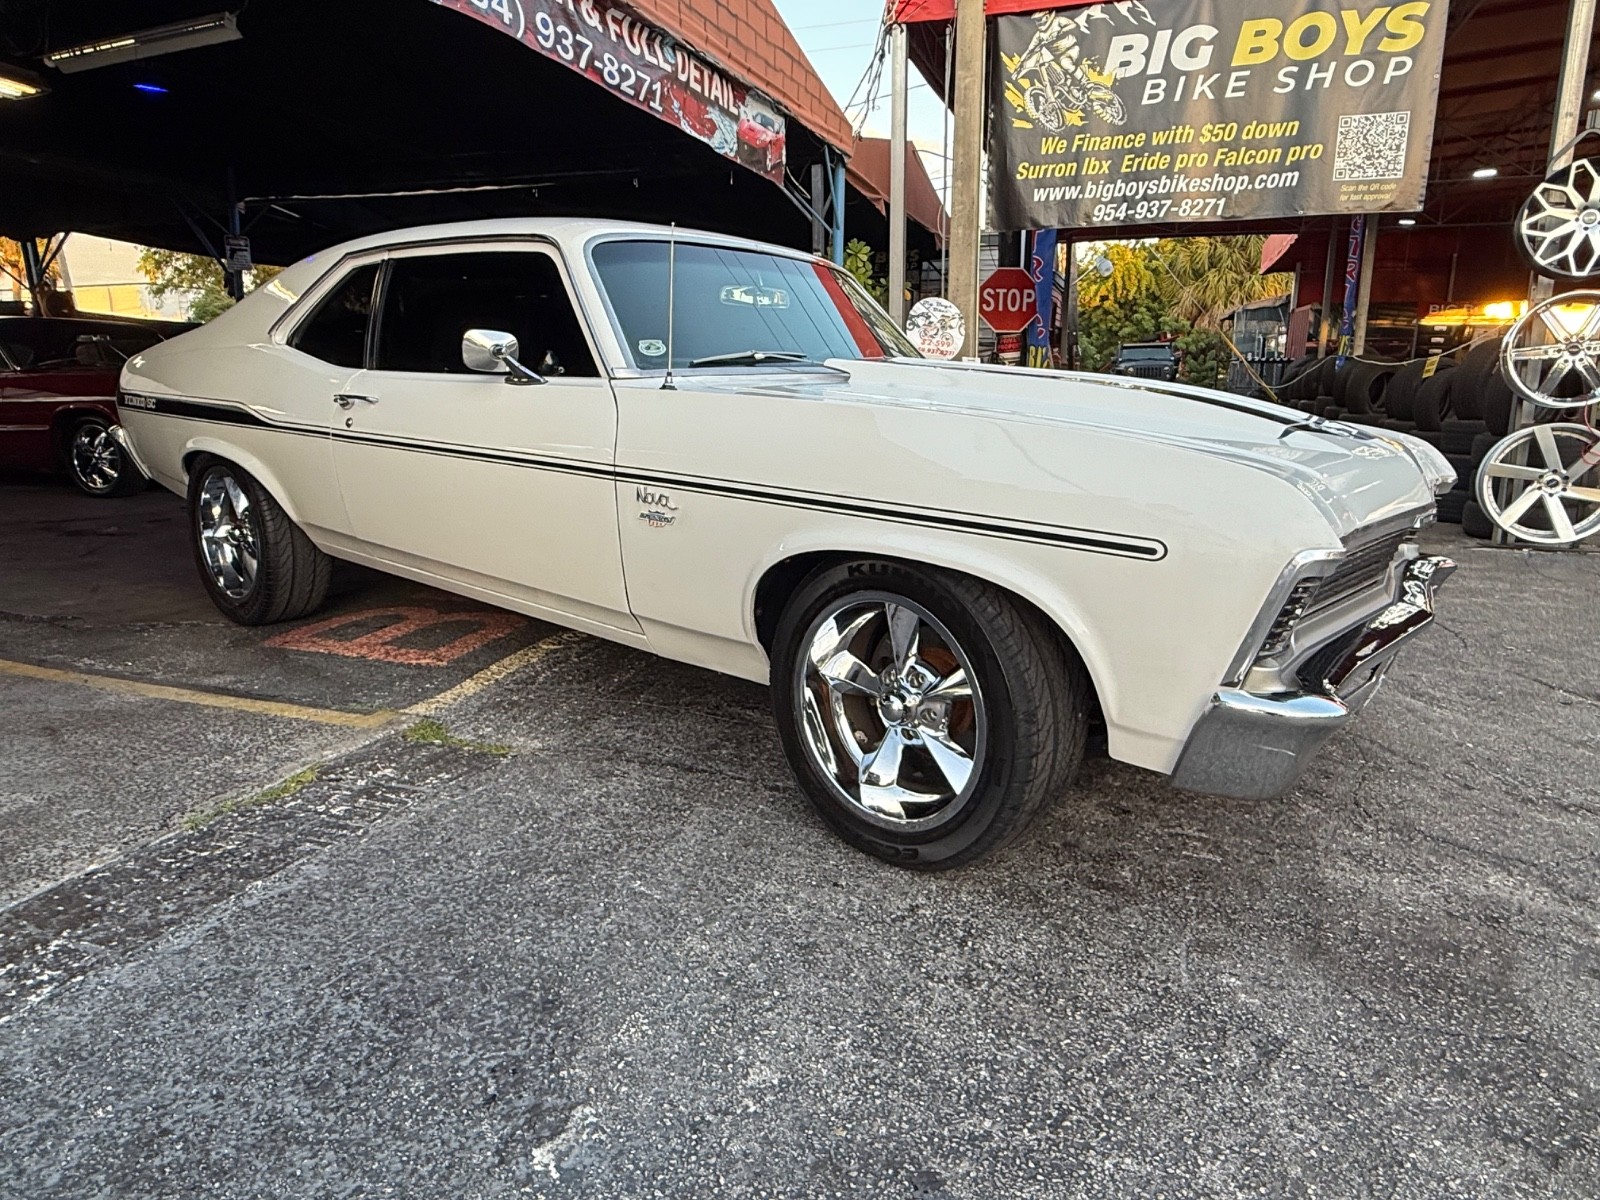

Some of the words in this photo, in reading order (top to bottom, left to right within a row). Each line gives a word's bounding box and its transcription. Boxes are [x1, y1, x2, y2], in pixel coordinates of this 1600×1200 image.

[1106, 24, 1219, 79] BIG
[1230, 2, 1431, 67] BOYS
[535, 11, 663, 113] 937-8271
[605, 7, 672, 73] FULL
[675, 49, 739, 115] DETAIL
[1141, 70, 1250, 105] BIKE
[1273, 56, 1413, 94] SHOP
[1040, 136, 1068, 155] We
[1071, 130, 1145, 153] Finance
[1151, 125, 1194, 146] with
[1199, 122, 1238, 144] $50
[1241, 119, 1300, 140] down
[1016, 160, 1075, 180] Surron
[1120, 152, 1170, 173] Eride
[1174, 152, 1208, 172] pro
[1213, 145, 1282, 167] Falcon
[1285, 142, 1324, 166] pro
[1033, 169, 1300, 203] www.bigboysbikeshop.com
[1092, 197, 1226, 222] 954-937-8271
[982, 287, 1036, 312] STOP
[636, 486, 679, 510] Nova
